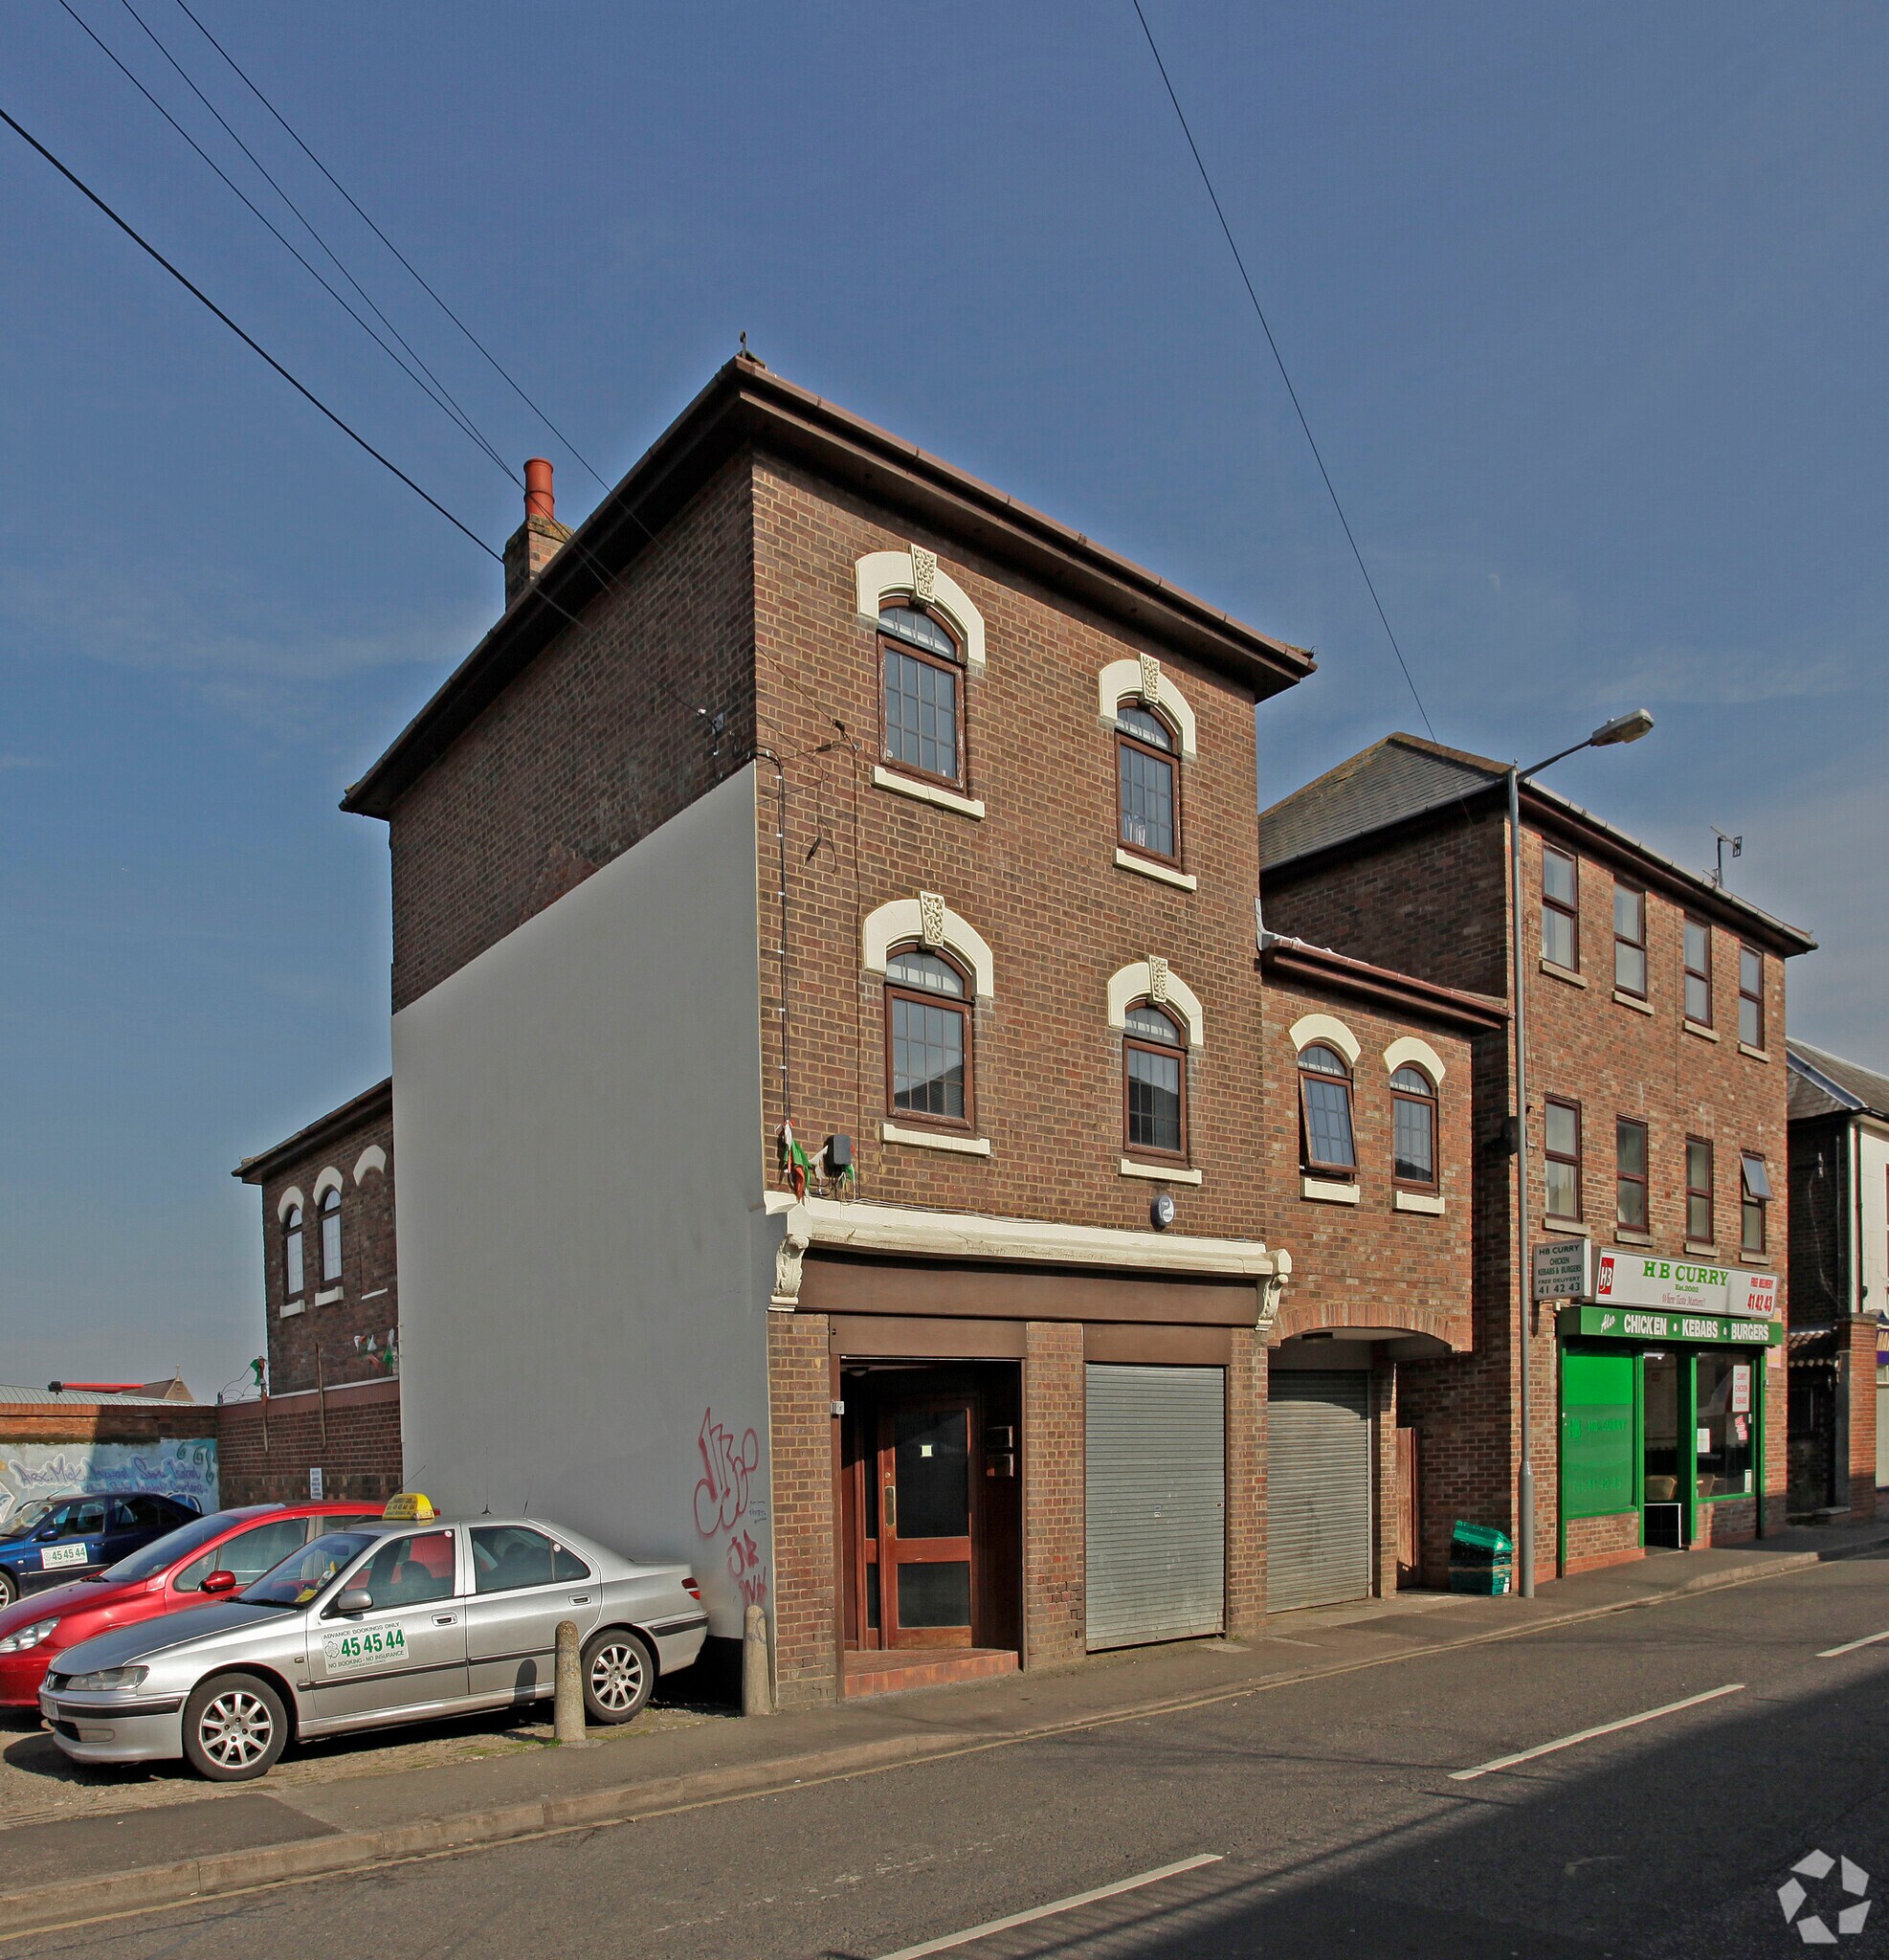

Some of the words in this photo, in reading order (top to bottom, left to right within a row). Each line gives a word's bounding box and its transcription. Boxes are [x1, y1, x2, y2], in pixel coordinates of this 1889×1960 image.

[1552, 1245, 1580, 1255] CURRY
[1549, 1257, 1570, 1265] CHICKEN
[1538, 1267, 1555, 1276] KEBABS
[1561, 1264, 1582, 1274] BURGERS
[1675, 1264, 1730, 1287] CURRY
[1539, 1285, 1549, 1294] 41
[1553, 1283, 1566, 1293] 42
[1568, 1282, 1581, 1292] 43
[1747, 1293, 1756, 1310] 41
[1755, 1294, 1765, 1311] 42
[1764, 1295, 1773, 1312] 43
[1623, 1314, 1667, 1336] CHICKEN
[1681, 1318, 1719, 1339] KEBABS
[1730, 1323, 1769, 1341] BURGERS
[52, 1550, 63, 1561] 45
[63, 1548, 75, 1559] 45
[75, 1547, 86, 1557] 44
[323, 1631, 351, 1639] ADVANCE
[352, 1625, 384, 1635] BOOKINGS
[341, 1637, 362, 1658] 45
[363, 1633, 383, 1654] 45
[386, 1629, 406, 1649] 44
[339, 1658, 363, 1666] BOOKING
[374, 1649, 405, 1659] INSURANCE
